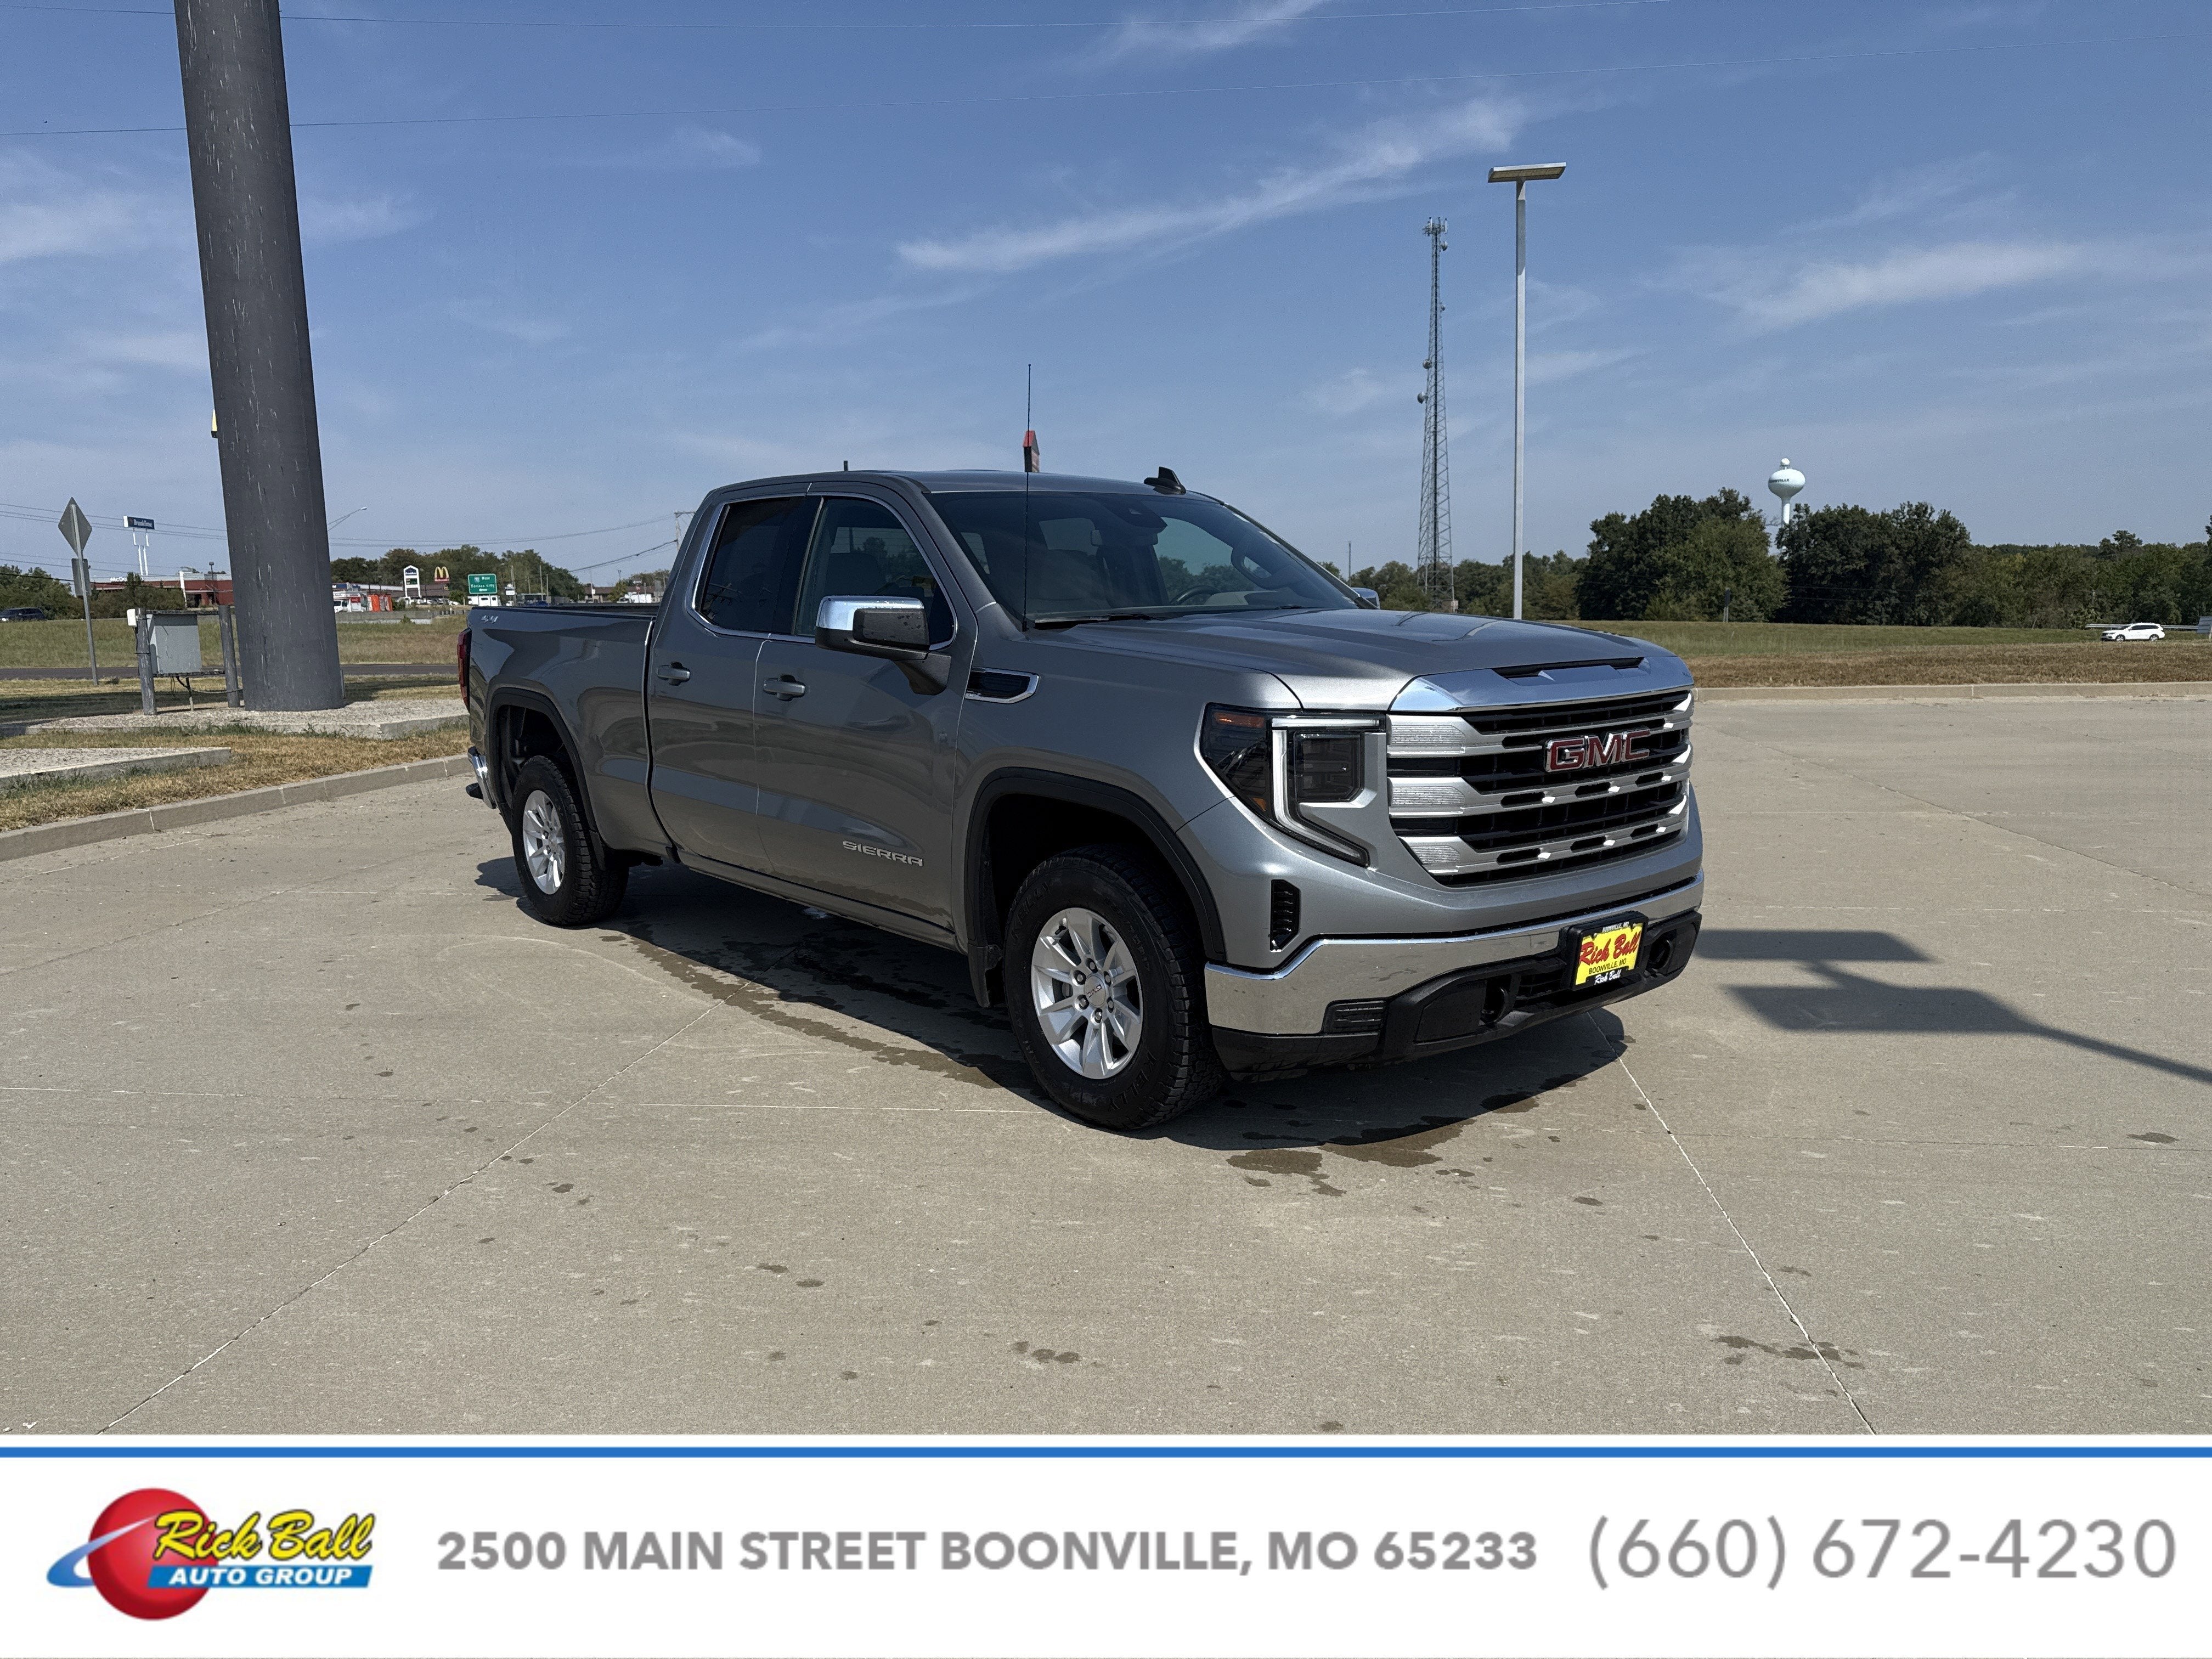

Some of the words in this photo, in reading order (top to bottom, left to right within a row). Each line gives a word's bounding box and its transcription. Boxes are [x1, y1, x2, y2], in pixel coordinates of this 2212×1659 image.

[1545, 729, 1651, 772] GMC
[843, 840, 924, 867] SIERRA
[1579, 938, 1611, 966] Rick
[1613, 930, 1641, 959] Ball
[1619, 958, 1627, 966] MO
[1087, 984, 1102, 998] GMC
